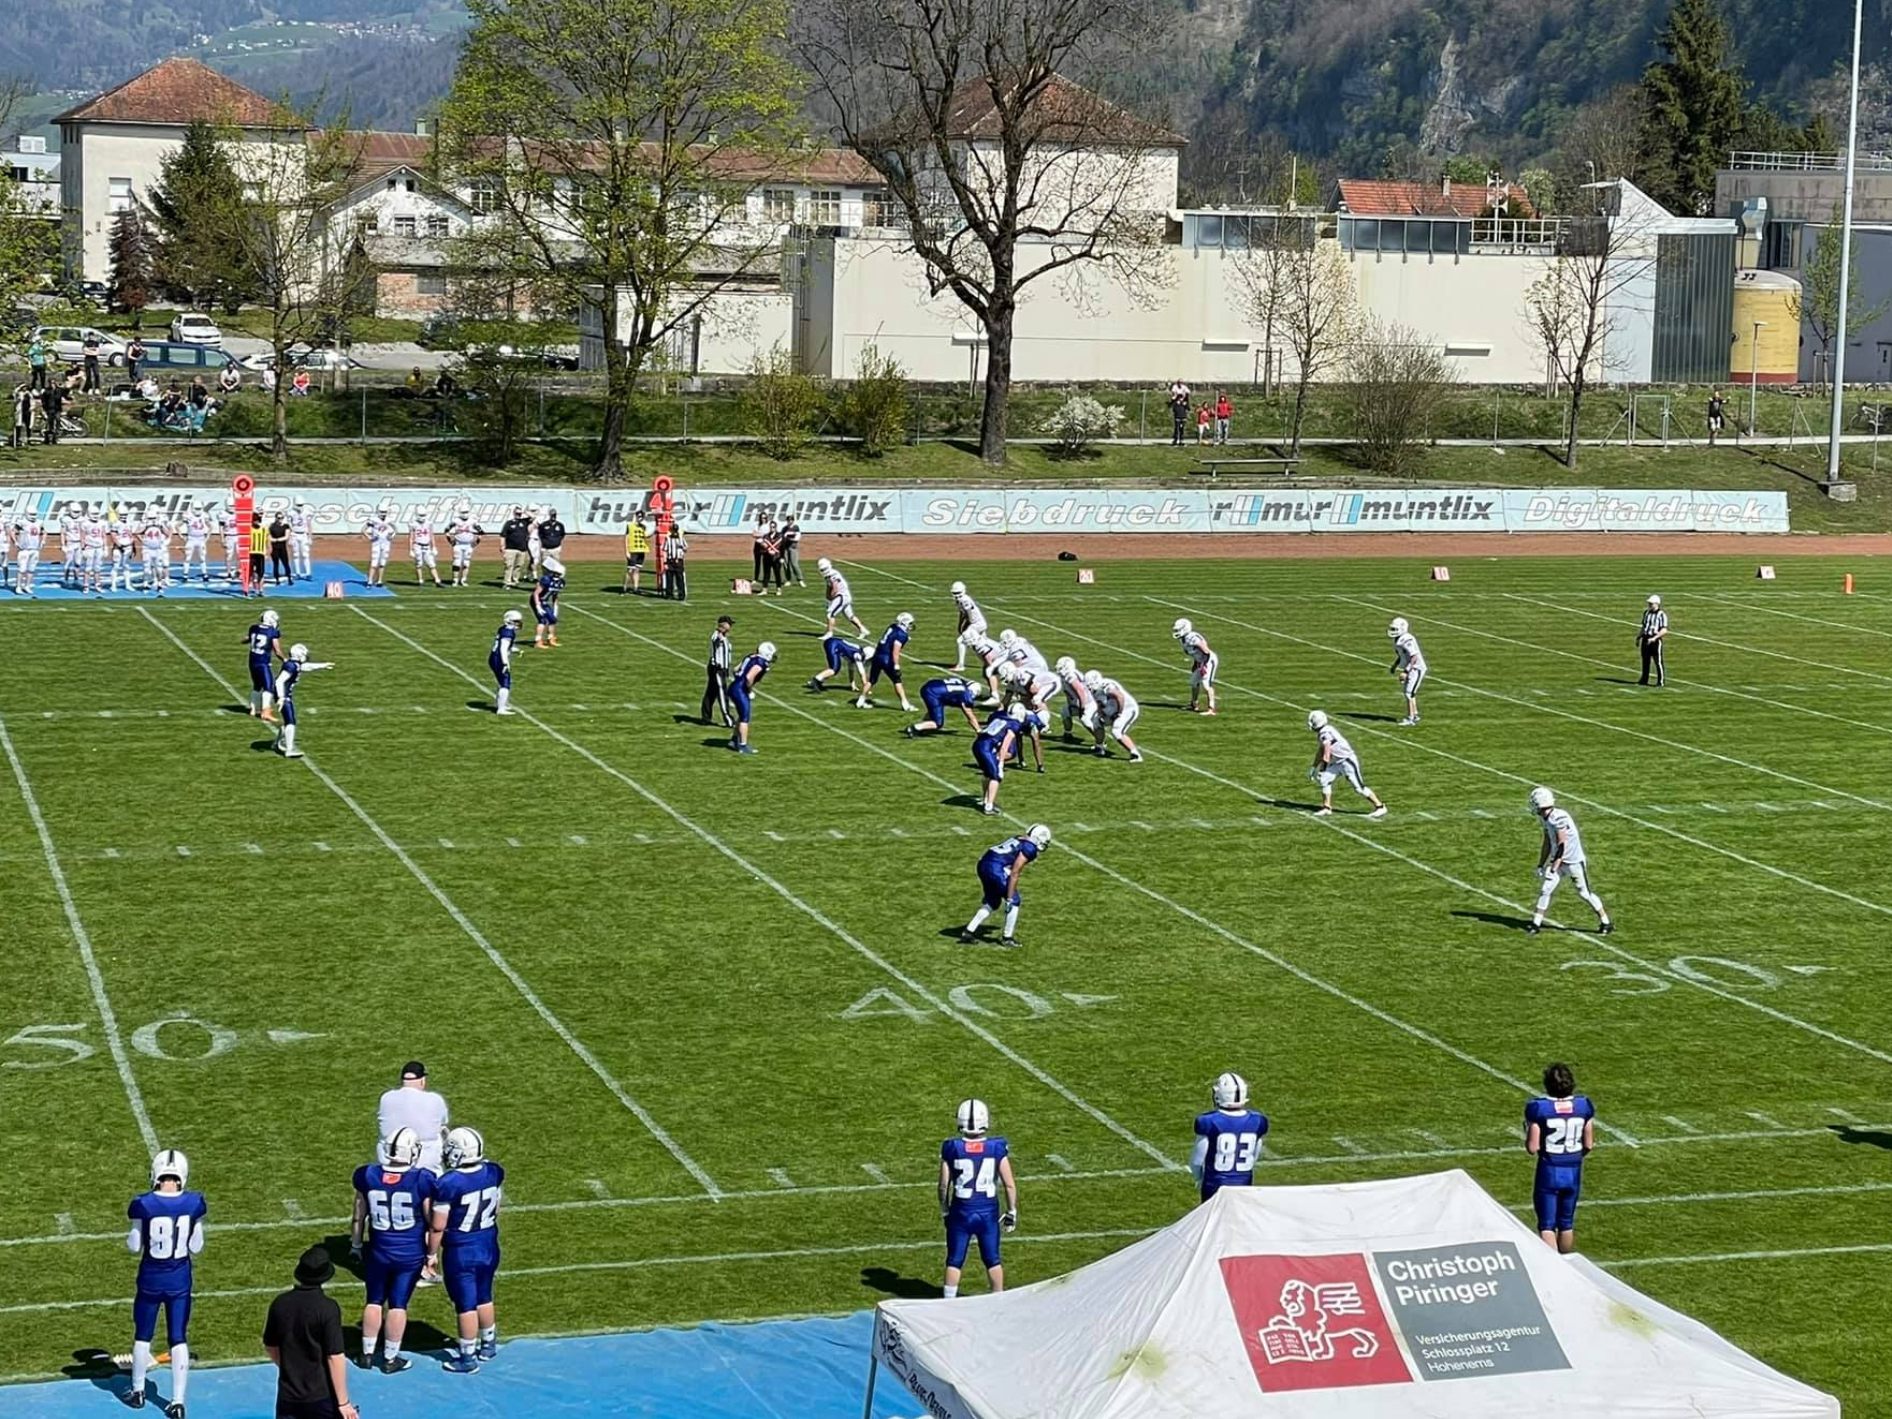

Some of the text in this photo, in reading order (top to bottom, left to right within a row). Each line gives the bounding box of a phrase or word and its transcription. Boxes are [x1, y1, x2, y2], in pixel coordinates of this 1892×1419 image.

[742, 495, 891, 521] muntlix
[922, 498, 1190, 526] Siebdruck
[1360, 494, 1495, 521] muntlix
[1524, 496, 1767, 527] Digitaldruck
[1545, 1117, 1585, 1154] 20
[1213, 1132, 1258, 1172] 83
[953, 1157, 997, 1199] 24
[367, 1189, 417, 1232] 66
[457, 1185, 500, 1233] 72
[149, 1214, 191, 1260] 81
[1387, 1250, 1516, 1282] Christoph
[1395, 1280, 1499, 1306] Piringer
[1415, 1325, 1541, 1346] Versicherungsagentur
[1421, 1341, 1511, 1360] Schlossplatz 12
[1427, 1358, 1496, 1374] Hohenems
